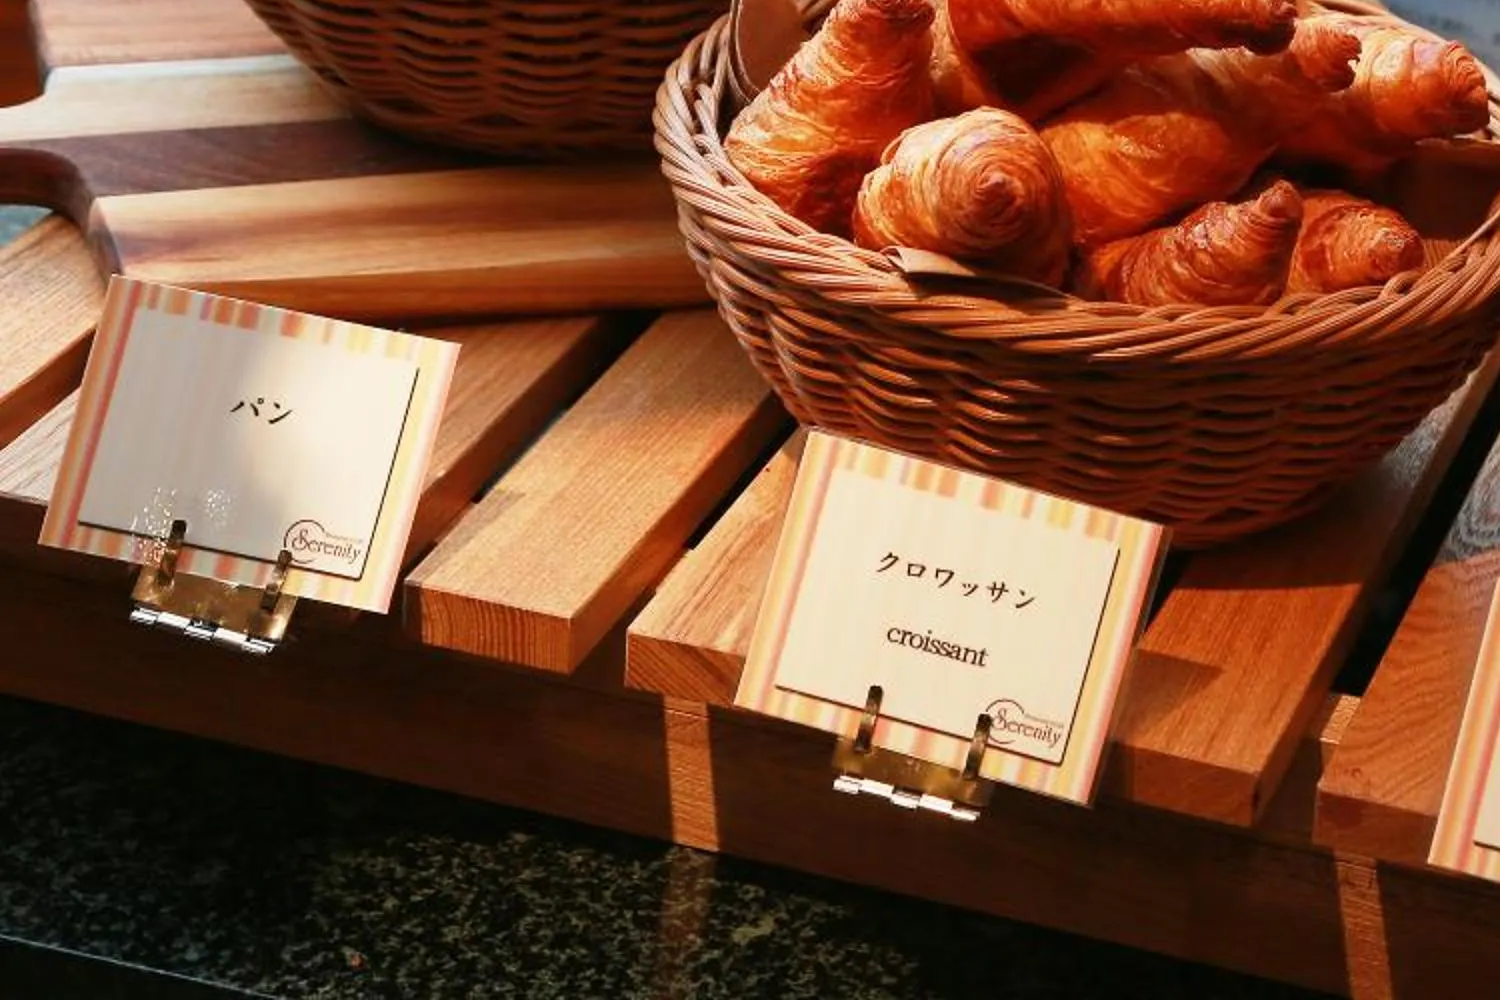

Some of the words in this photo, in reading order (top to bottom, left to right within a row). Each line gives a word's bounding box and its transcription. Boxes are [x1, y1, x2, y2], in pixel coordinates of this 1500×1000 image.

[230, 396, 293, 425] パン
[291, 528, 362, 565] Serenity
[876, 551, 1037, 610] クロワッサン
[886, 624, 990, 668] croissant
[991, 707, 1062, 749] Serenity
